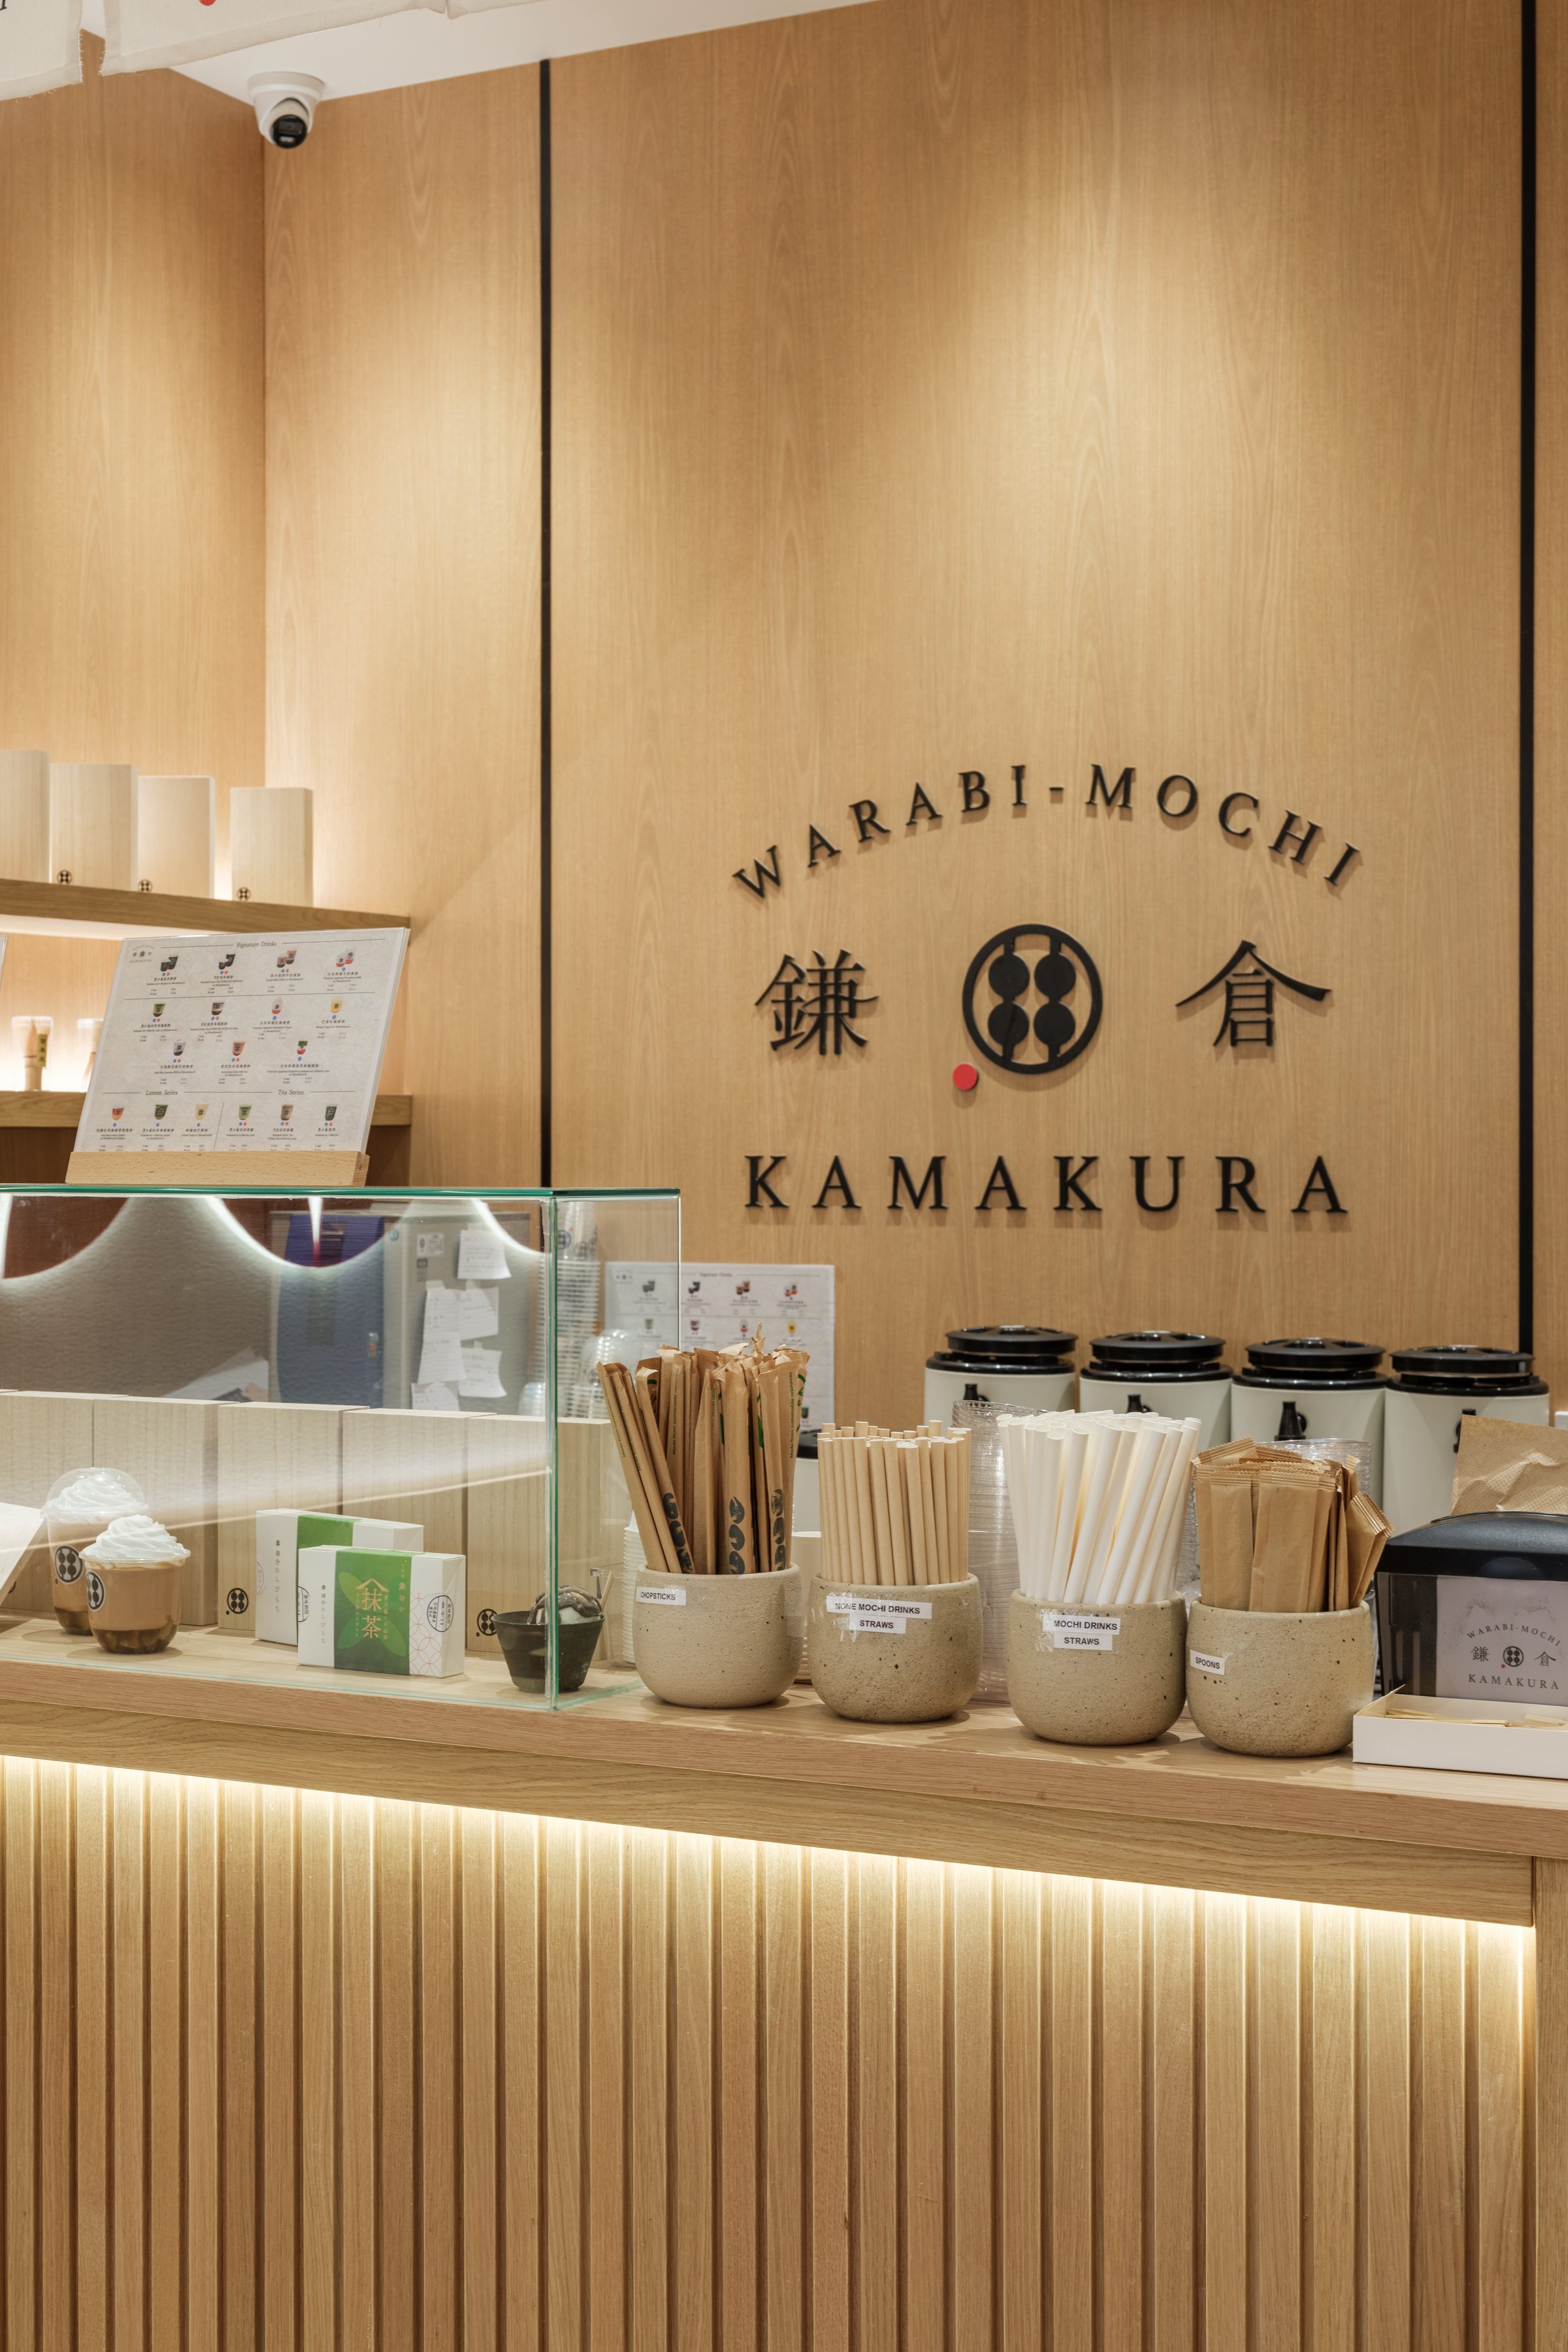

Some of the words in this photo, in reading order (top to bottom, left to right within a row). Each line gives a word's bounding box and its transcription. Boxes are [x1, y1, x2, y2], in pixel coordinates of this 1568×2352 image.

[732, 764, 1359, 900] WARABI-MOCHI
[754, 949, 879, 1056] 鎌
[1175, 939, 1333, 1048] 倉
[743, 1154, 1348, 1215] KAMAKURA
[640, 1592, 676, 1601] CHOPSTICKS
[361, 1588, 382, 1639] 抹茶
[858, 1603, 886, 1612] MOCHI
[888, 1605, 920, 1614] DRINKS
[859, 1620, 894, 1629] STRAWS
[1053, 1620, 1082, 1629] MOCHI
[1084, 1622, 1118, 1631] DRINKS
[1064, 1637, 1100, 1645] STRAWS
[1467, 1624, 1561, 1647] WARABI-MOCHI
[1195, 1656, 1220, 1669] SPOONS
[1470, 1646, 1490, 1662] 鎌
[1534, 1651, 1556, 1667] 倉
[1468, 1673, 1559, 1690] KAMAKURA
